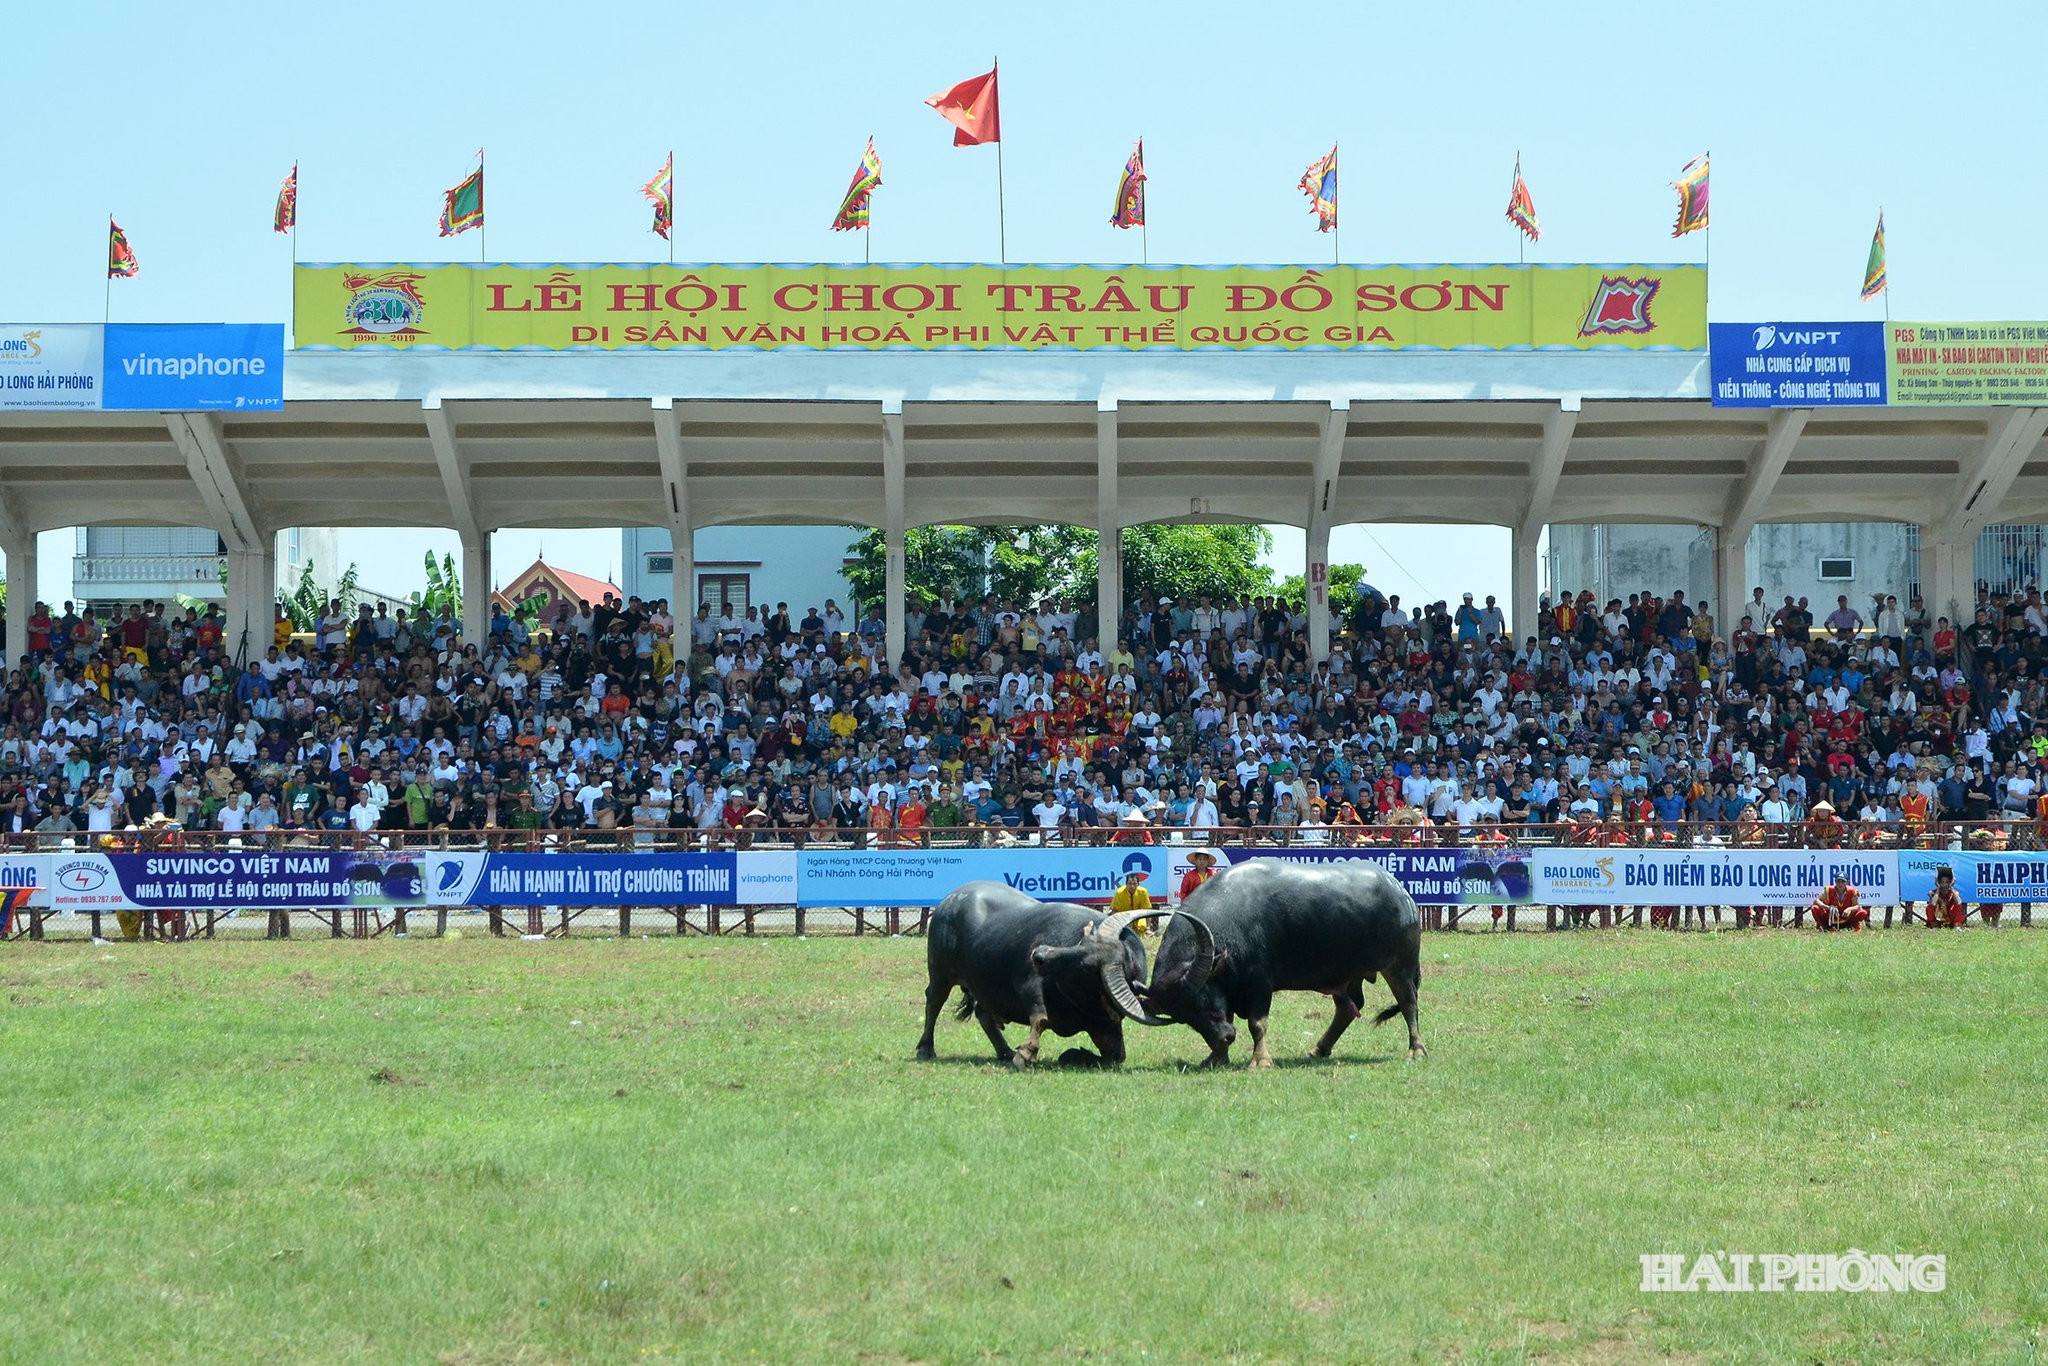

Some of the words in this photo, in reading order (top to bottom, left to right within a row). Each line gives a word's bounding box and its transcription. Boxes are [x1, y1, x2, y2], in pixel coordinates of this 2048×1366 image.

[486, 272, 582, 312] LỄ
[606, 275, 747, 318] HỘI
[773, 284, 962, 318] CHỌI
[987, 276, 1195, 312] TRÂU
[1224, 270, 1333, 312] ĐỒ
[1356, 280, 1510, 312] SƠN
[364, 299, 405, 321] 30
[353, 334, 378, 342] 1990
[390, 334, 416, 342] 2019
[572, 326, 609, 342] DI
[624, 320, 707, 342] SẢN
[721, 322, 805, 342] VĂN
[823, 322, 911, 342] HOÁ
[926, 326, 989, 342] PHI
[1003, 322, 1084, 346] VẬT
[1097, 318, 1175, 342] THỂ
[1190, 320, 1309, 343] QUỐC
[1324, 326, 1395, 342] GIA
[1778, 331, 1841, 345] VNPT
[1895, 329, 1915, 342] PGS
[2007, 328, 2020, 340] PGS
[1746, 354, 1765, 373] NHÀ
[1767, 357, 1792, 373] CUNG
[1794, 352, 1812, 373] CẤP
[1815, 356, 1836, 376] DỊCH
[1838, 356, 1850, 376] VỤ
[1952, 347, 1966, 364] BAO
[1977, 347, 2004, 364] CARTON
[122, 353, 266, 380] vinaphone
[1902, 368, 1939, 376] PRINTING
[1946, 368, 1977, 376] CARTON
[7, 375, 34, 389] LONG
[37, 370, 55, 389] HẢI
[58, 372, 94, 389] PHÒNG
[1718, 378, 1739, 399] VIỄN
[1741, 380, 1772, 399] THÔNG
[1779, 380, 1805, 399] CÔNG
[1806, 380, 1831, 401] NGHỆ
[1833, 380, 1863, 399] THÔNG
[1864, 382, 1880, 398] TIN
[55, 861, 81, 877] SUVINCO
[95, 863, 110, 876] NAM
[146, 858, 235, 875] SUVINCO
[240, 854, 280, 878] VIỆT
[285, 857, 330, 873] NAM
[807, 858, 828, 866] Ngân
[829, 858, 849, 866] Hàng
[874, 857, 896, 866] Công
[927, 857, 942, 865] Việt
[1412, 857, 1455, 873] NAM
[1625, 854, 1658, 886] BẢO
[1664, 855, 1704, 886] HIỂM
[1711, 854, 1743, 887] BẢO
[1749, 864, 1791, 887] LONG
[1797, 855, 1823, 887] HẢI
[1, 862, 37, 888] ÒNG
[490, 865, 520, 893] HÂN
[524, 869, 564, 897] HẠNH
[567, 865, 589, 892] TÀI
[593, 869, 621, 898] TRỢ
[624, 867, 683, 892] CHƯƠNG
[687, 864, 729, 892] TRÌNH
[741, 873, 793, 885] vinaphone
[807, 869, 822, 878] Chi
[825, 868, 856, 878] Nhánh
[859, 868, 884, 879] Đông
[887, 868, 902, 877] Hải
[904, 868, 934, 879] Phòng
[1003, 871, 1124, 892] VietinBank
[1544, 866, 1567, 878] BAO
[1570, 866, 1600, 879] LONG
[1976, 862, 2048, 885] HAIPH
[136, 881, 163, 898] NHÀ
[166, 881, 187, 898] TÀI
[190, 883, 216, 901] TRỢ
[218, 878, 233, 898] LỄ
[237, 881, 259, 900] HỘI
[262, 883, 292, 900] CHỌI
[296, 880, 330, 897] TRÂU
[332, 877, 349, 897] ĐỒ
[354, 880, 381, 896] SƠN
[1409, 878, 1440, 895] TRÂU
[1444, 876, 1461, 895] ĐỒ
[1464, 878, 1491, 895] SƠN
[1977, 887, 2030, 898] PREMIUM
